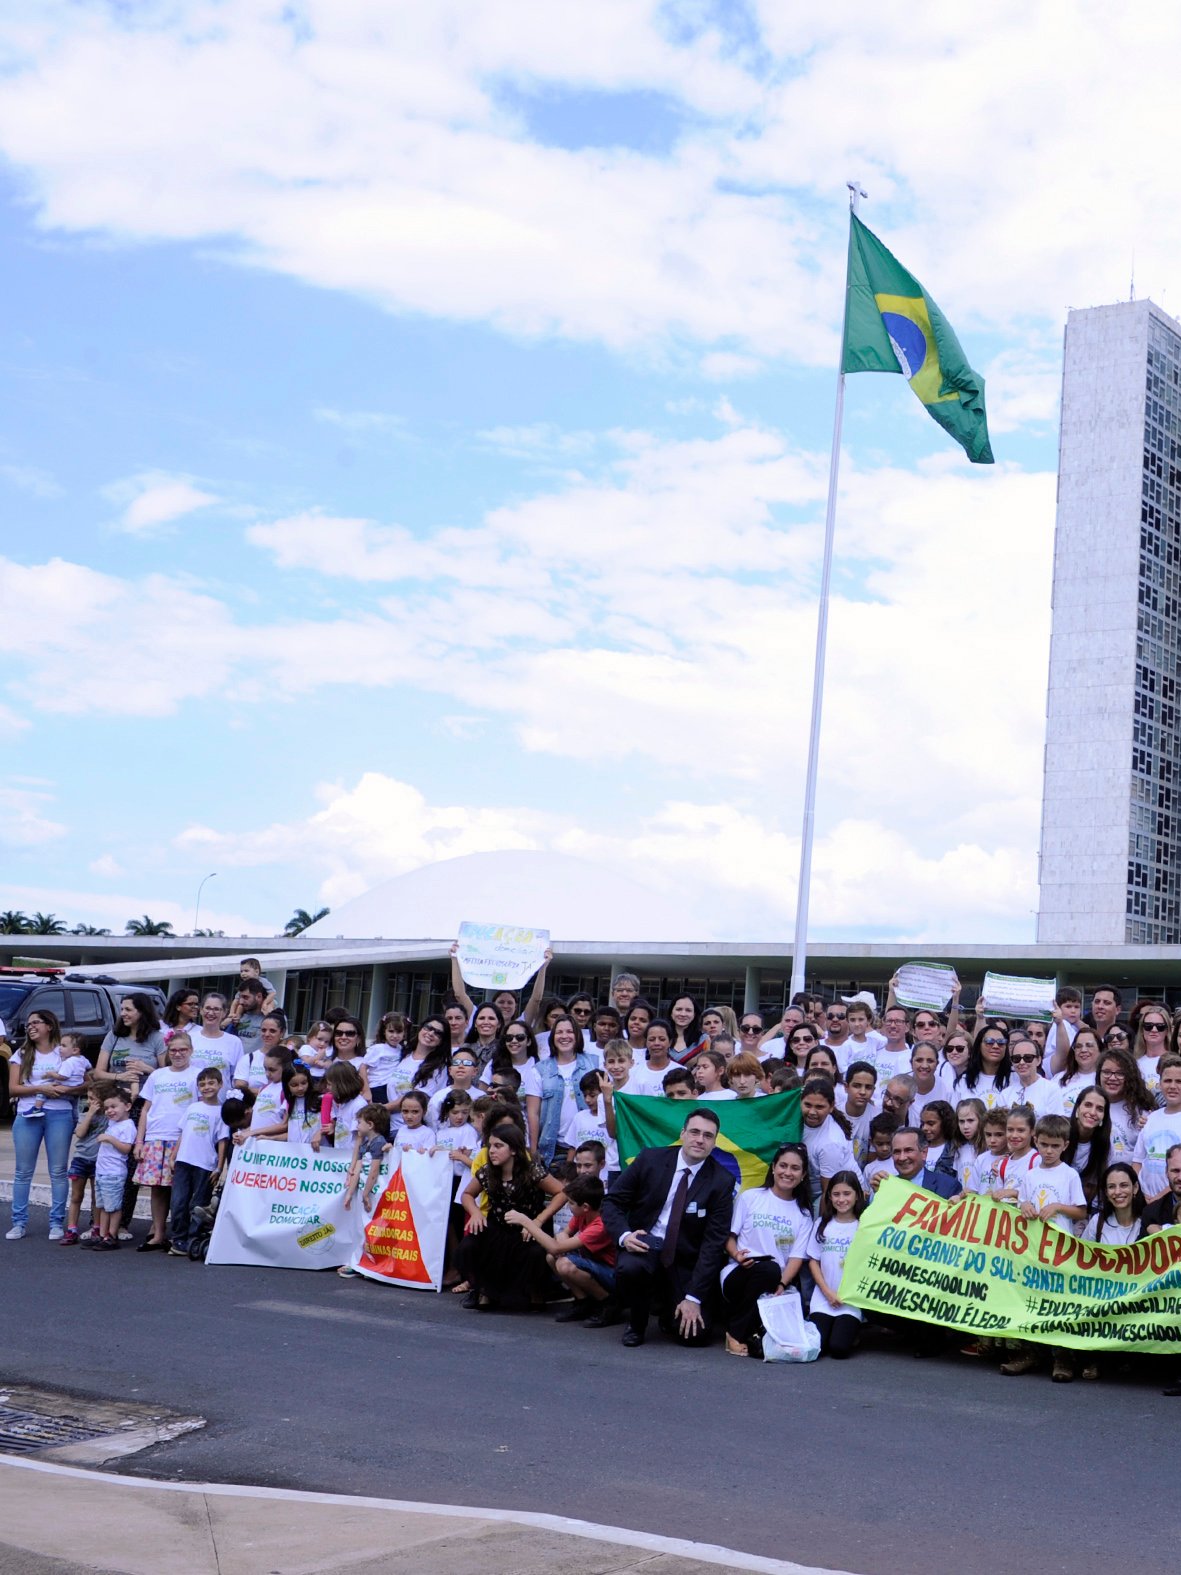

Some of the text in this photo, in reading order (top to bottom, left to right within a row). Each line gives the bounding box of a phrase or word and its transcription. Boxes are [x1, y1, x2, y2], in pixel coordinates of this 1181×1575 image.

[237, 1149, 308, 1170] CUMPRIMOS
[312, 1159, 351, 1173] NOSSO
[231, 1168, 297, 1192] QUEREMOS
[299, 1180, 346, 1194] NOSSO
[385, 1190, 406, 1202] SOS
[753, 1212, 792, 1226] EDUCAÇÃO
[892, 1192, 1029, 1254] FAMÍLIAS
[877, 1226, 907, 1250] RIO
[907, 1234, 965, 1268] GRANDE
[963, 1249, 986, 1274] DO
[990, 1256, 1017, 1283] SUL
[1021, 1265, 1065, 1294] SANTA
[867, 1252, 989, 1302] #HOMESCHOOLING
